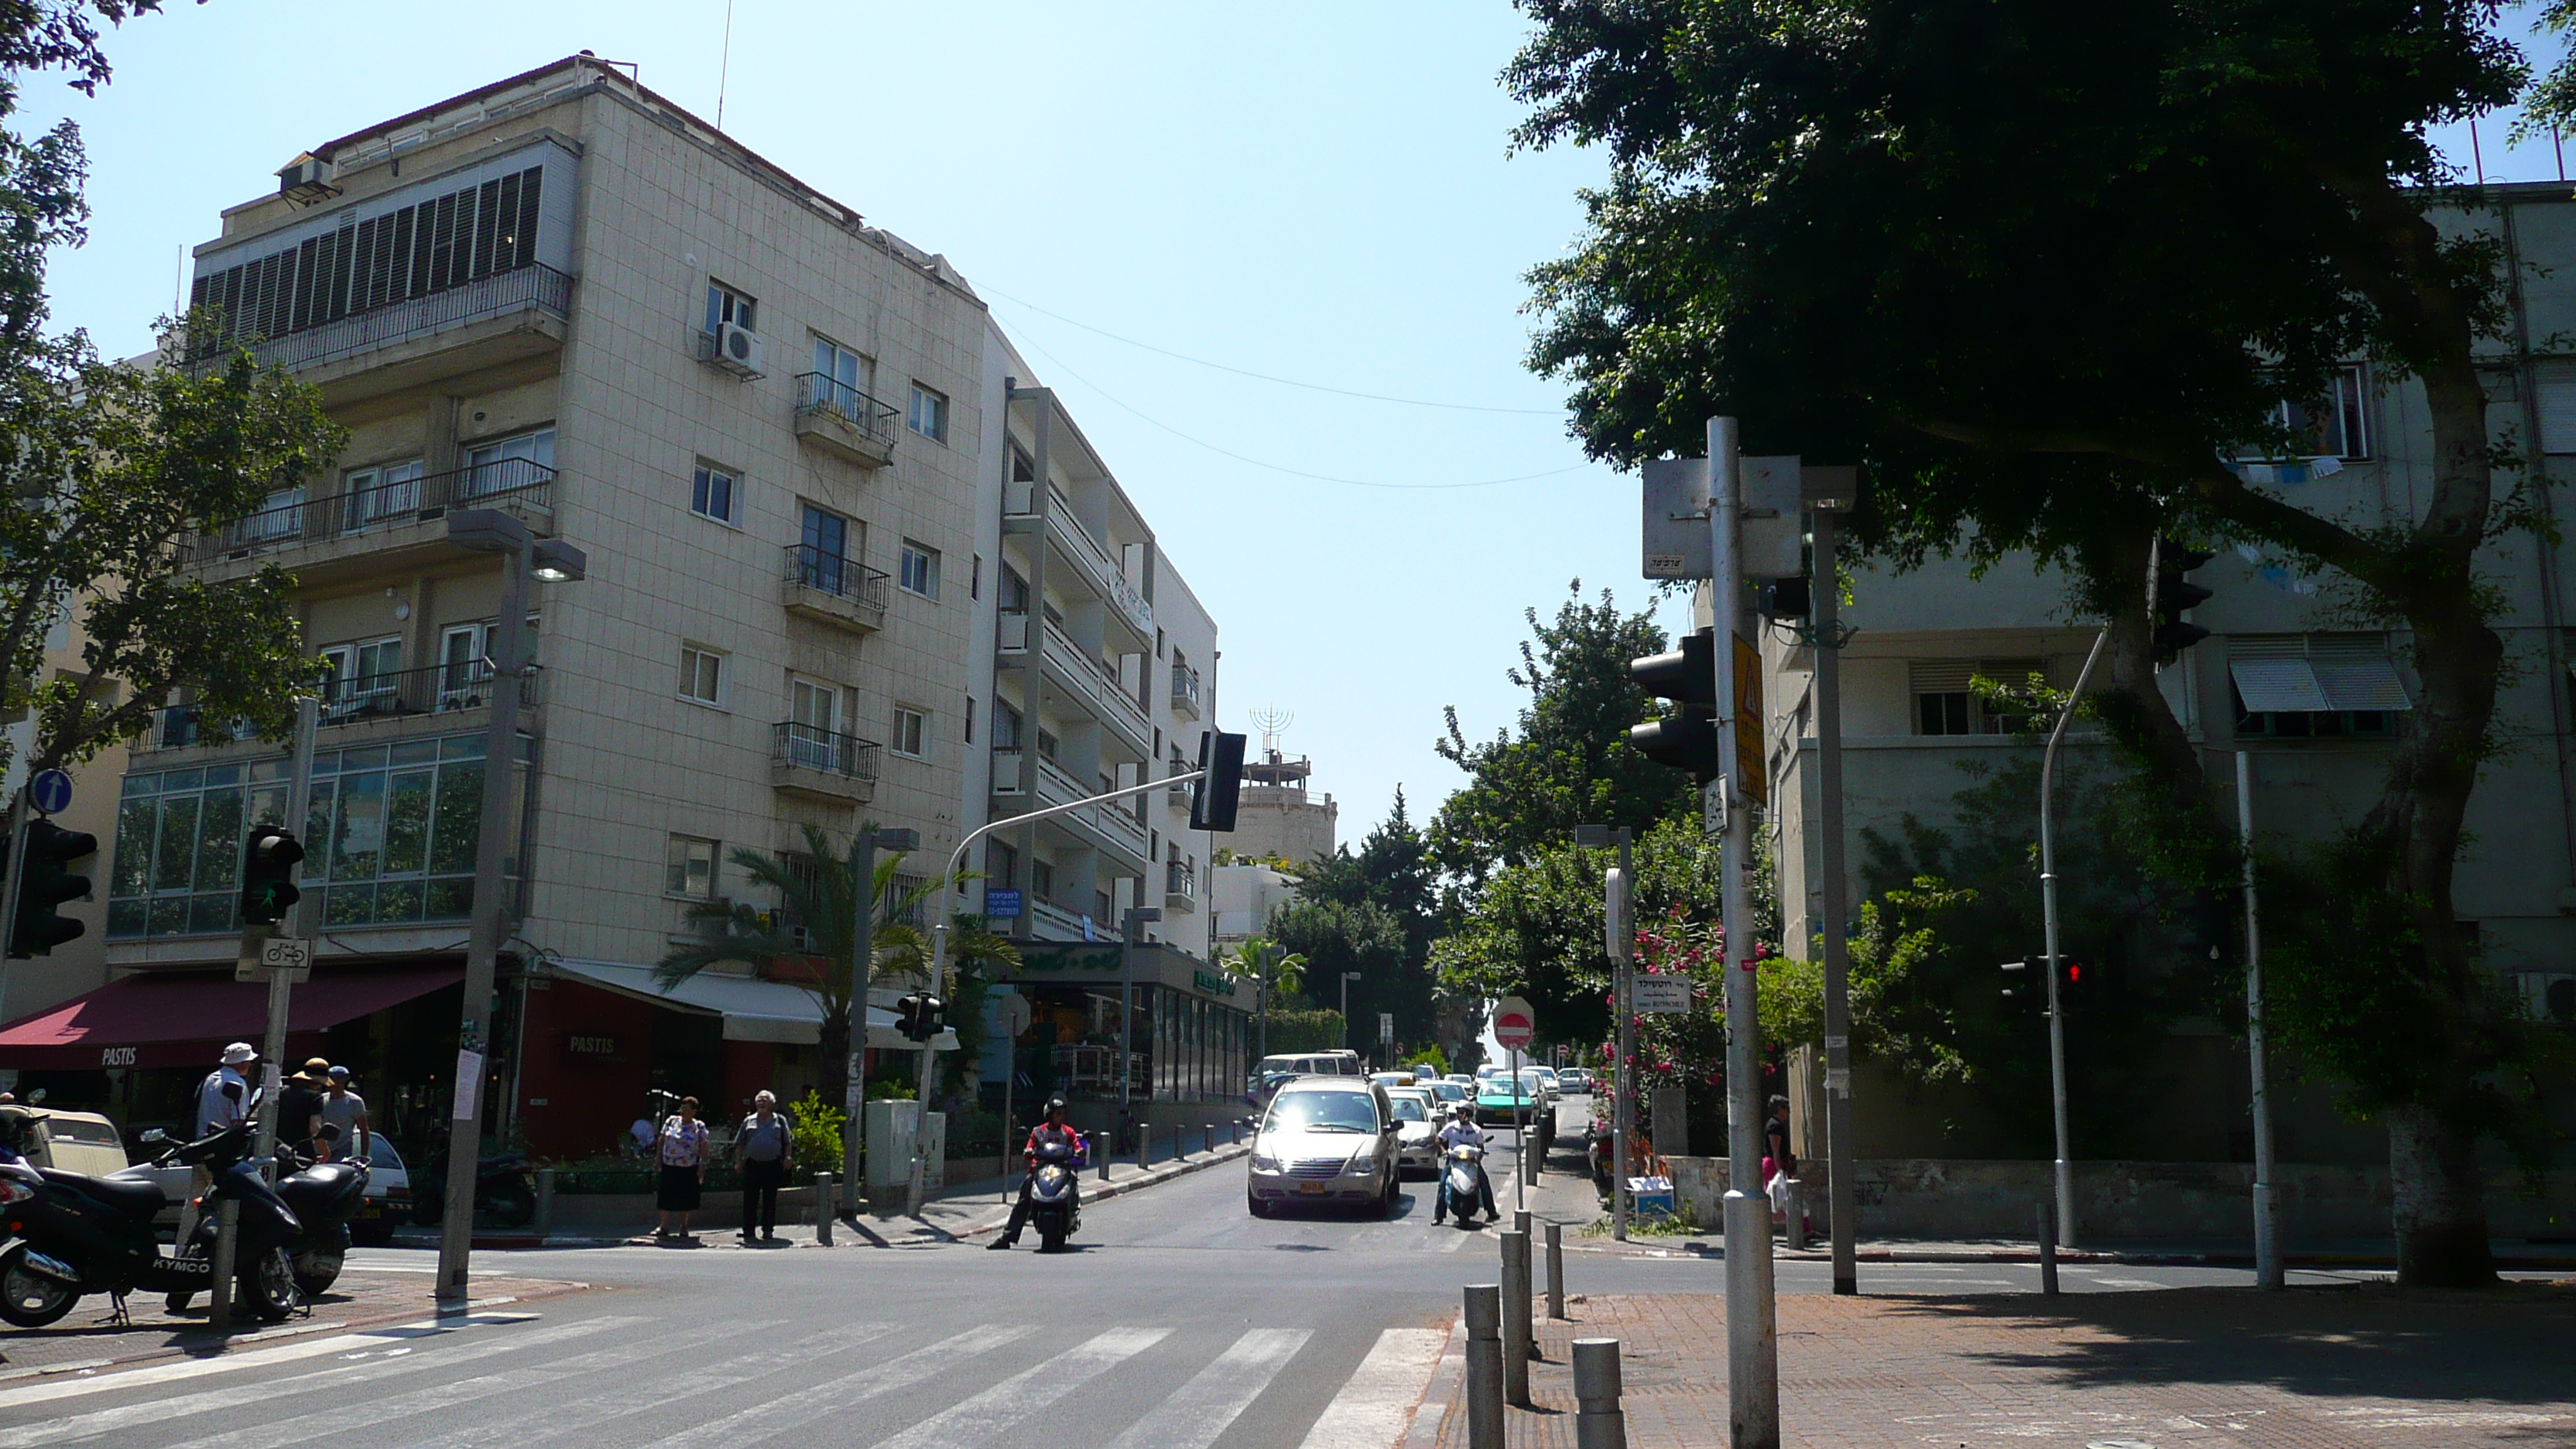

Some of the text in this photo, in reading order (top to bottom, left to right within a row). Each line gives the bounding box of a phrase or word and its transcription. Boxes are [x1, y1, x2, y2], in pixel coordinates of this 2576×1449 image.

[1637, 978, 1672, 988] רוטשילד
[570, 1036, 615, 1053] PASTIS
[101, 1047, 137, 1066] PASTIS
[152, 1259, 210, 1273] KYMCO
